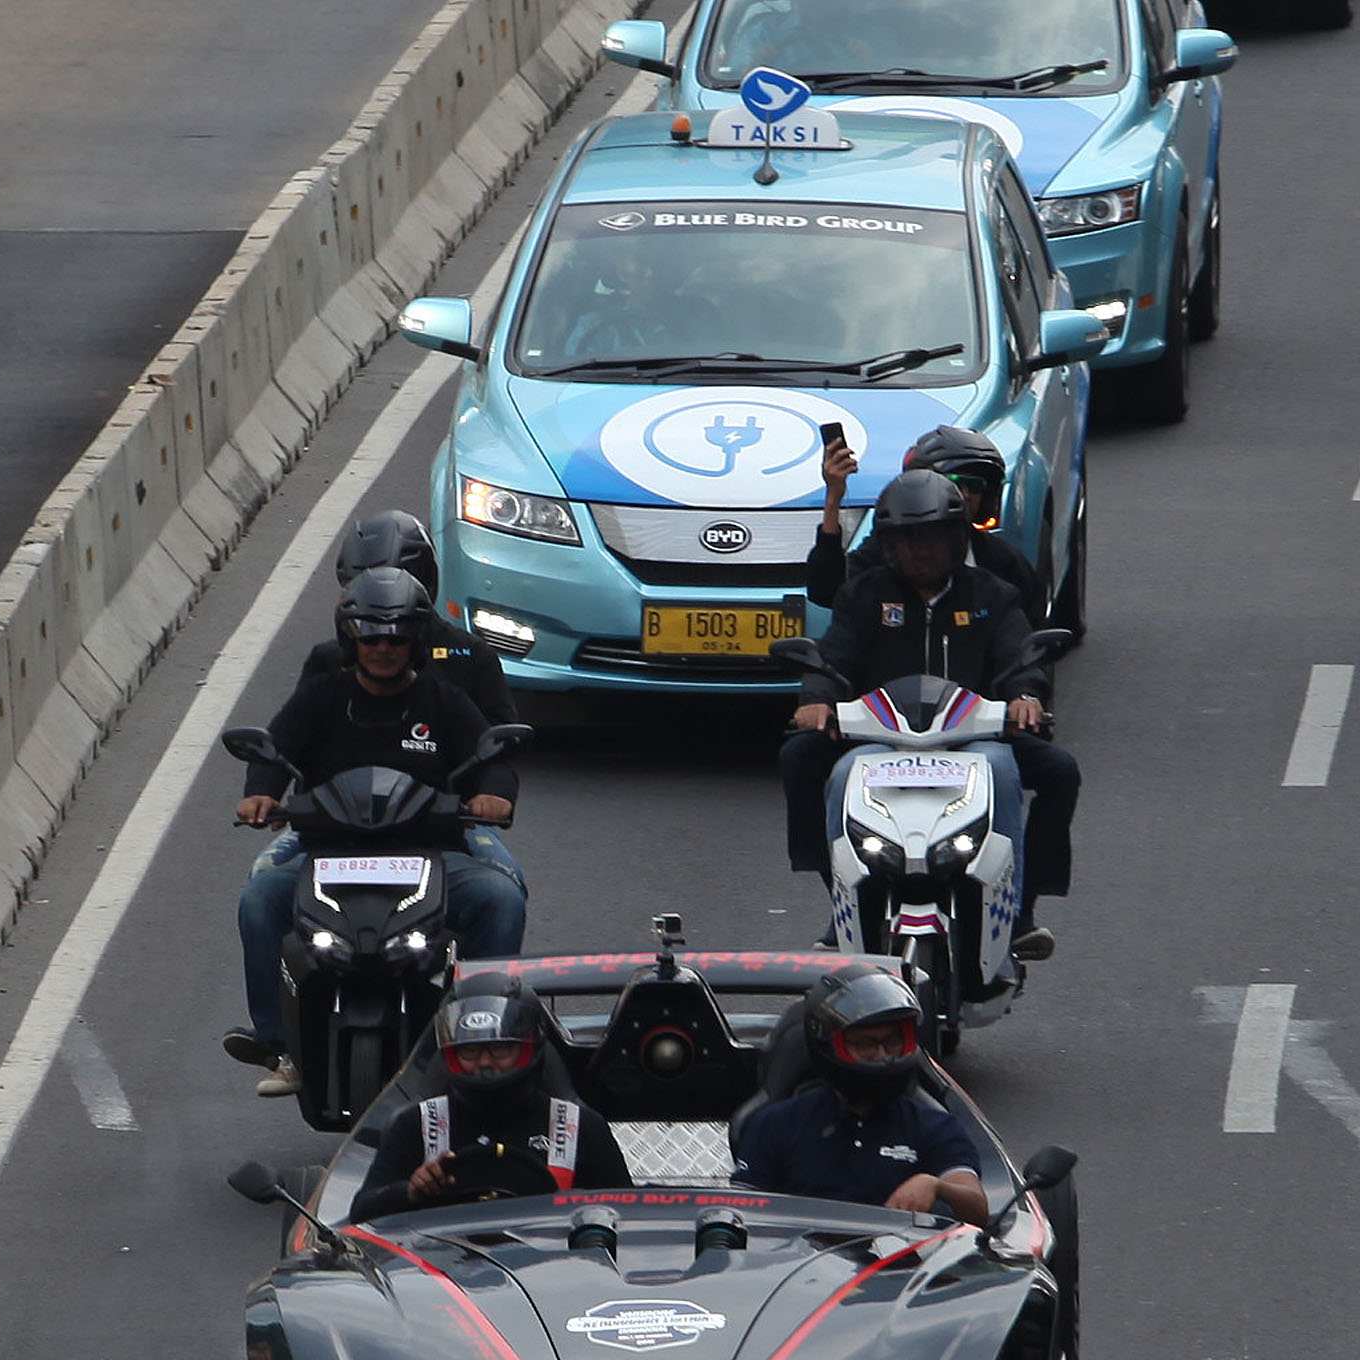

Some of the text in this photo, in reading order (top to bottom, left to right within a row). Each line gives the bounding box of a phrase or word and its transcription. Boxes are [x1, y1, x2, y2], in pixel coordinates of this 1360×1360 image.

[731, 125, 819, 143] TAKSI
[653, 212, 924, 234] BLUE BIRD GROUP
[706, 530, 744, 543] BYD
[648, 611, 660, 637] B
[686, 613, 737, 638] 1503
[554, 1104, 568, 1159] BRIDE
[643, 1194, 690, 1205] BUT
